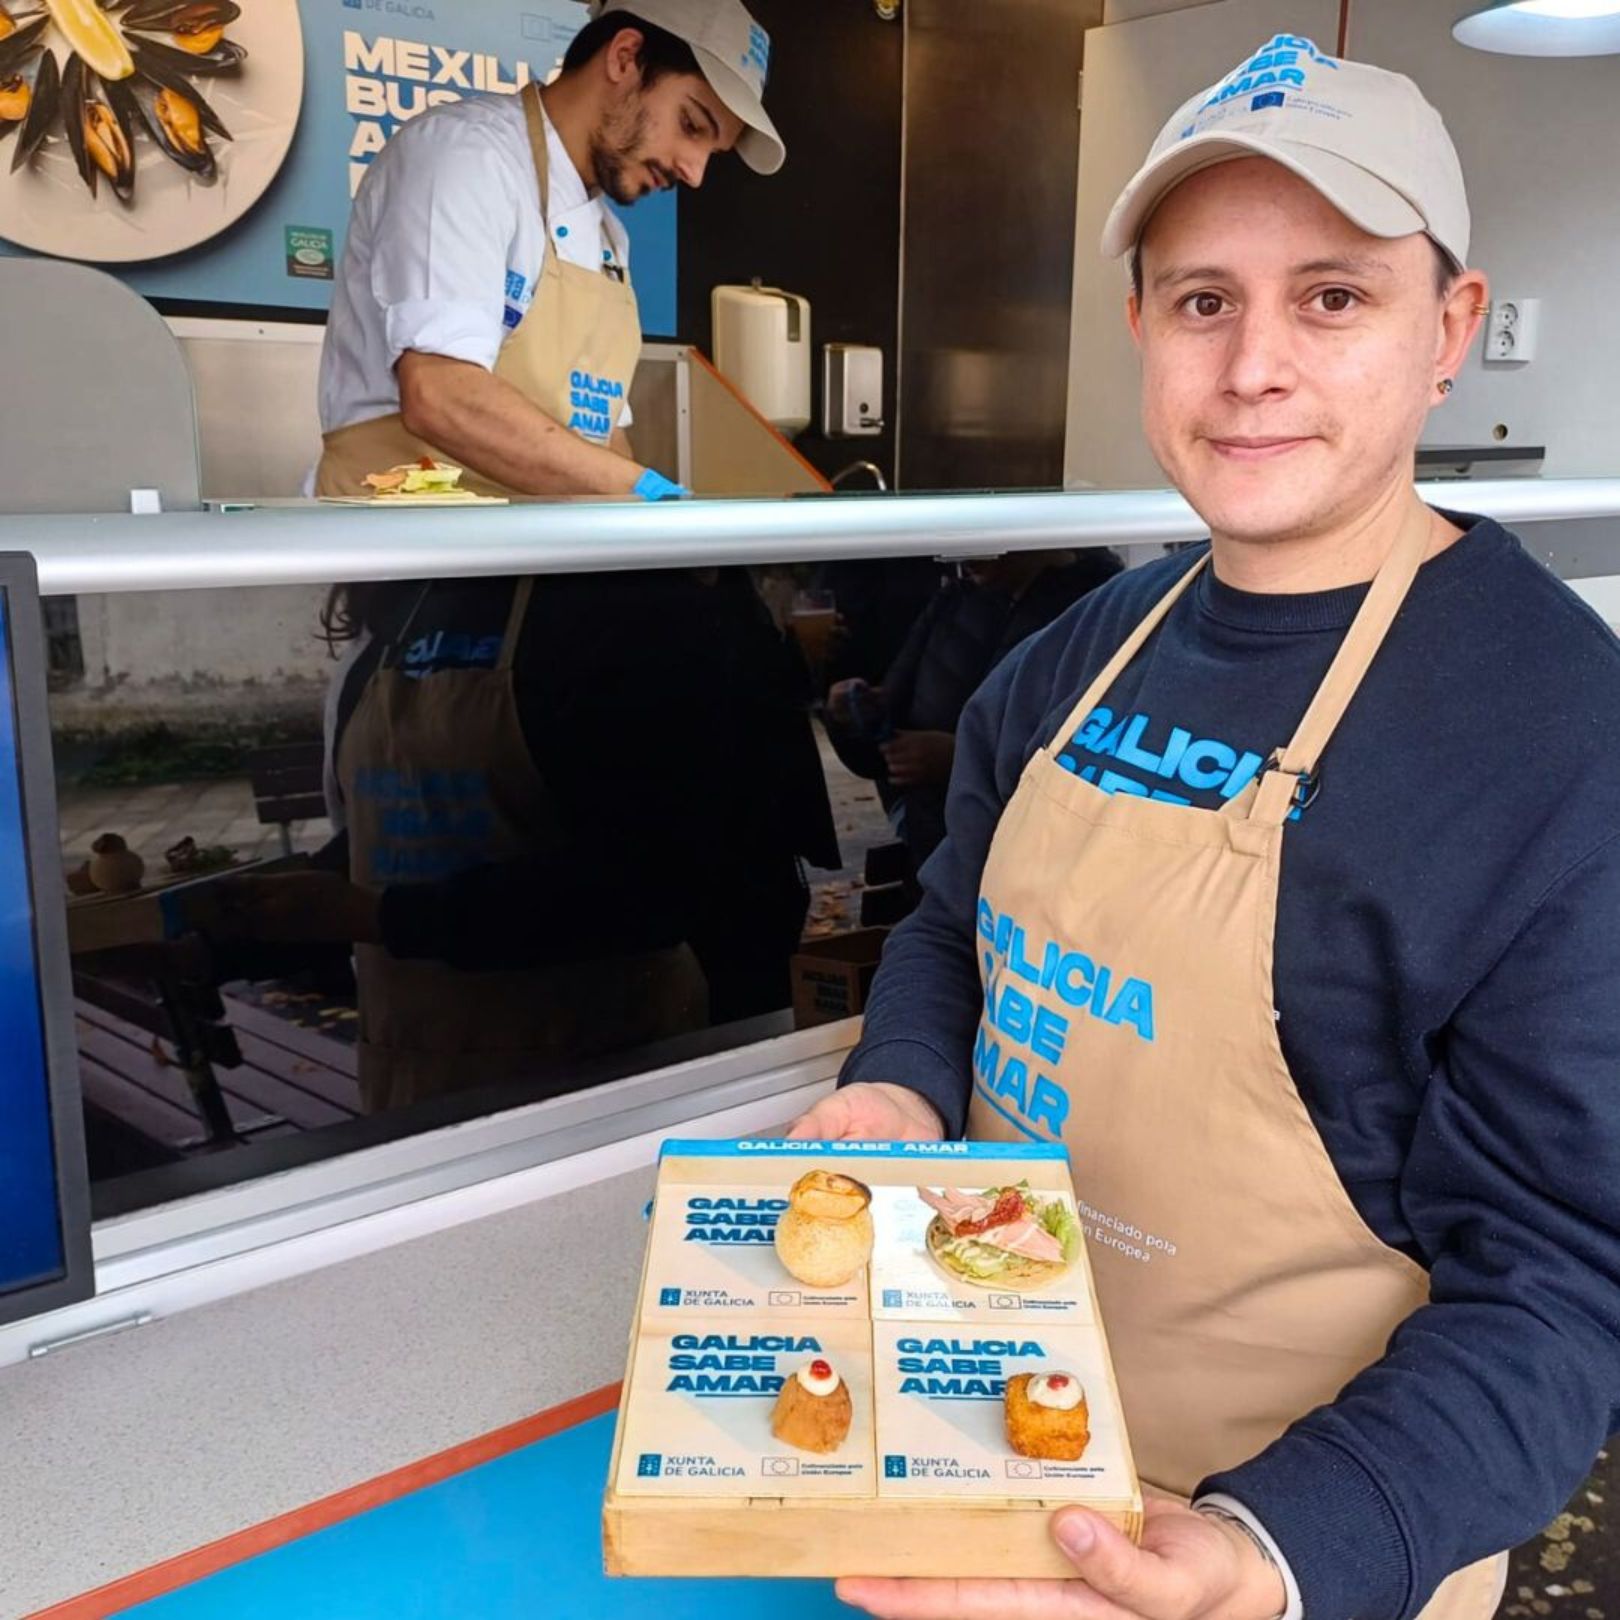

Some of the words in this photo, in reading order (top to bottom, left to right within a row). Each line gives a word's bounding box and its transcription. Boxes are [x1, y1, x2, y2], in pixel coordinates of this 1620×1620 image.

[343, 31, 562, 95] MEXILL
[1073, 707, 1263, 799] GALICI
[975, 1030, 1070, 1138] MAR
[737, 1141, 823, 1151] GALICIA
[831, 1142, 891, 1152] SABE
[902, 1143, 969, 1154] AMAR
[687, 1198, 791, 1211] GALIC
[1078, 1200, 1142, 1240] financiado
[1145, 1234, 1177, 1257] pola
[1095, 1227, 1151, 1263] Europea
[683, 1298, 699, 1306] DE
[704, 1298, 755, 1306] GALICIA
[671, 1335, 822, 1352] GALICIA
[896, 1339, 1046, 1357] GALICIA
[668, 1355, 776, 1371] SABE
[897, 1358, 1002, 1376] SABE
[665, 1375, 786, 1392] AMAR
[667, 1456, 716, 1465] XUNTA
[912, 1457, 960, 1467] XUNTA
[664, 1467, 684, 1476] DE
[688, 1467, 746, 1476] GALICIA
[911, 1468, 929, 1477] DE
[934, 1468, 991, 1478] GALICIA
